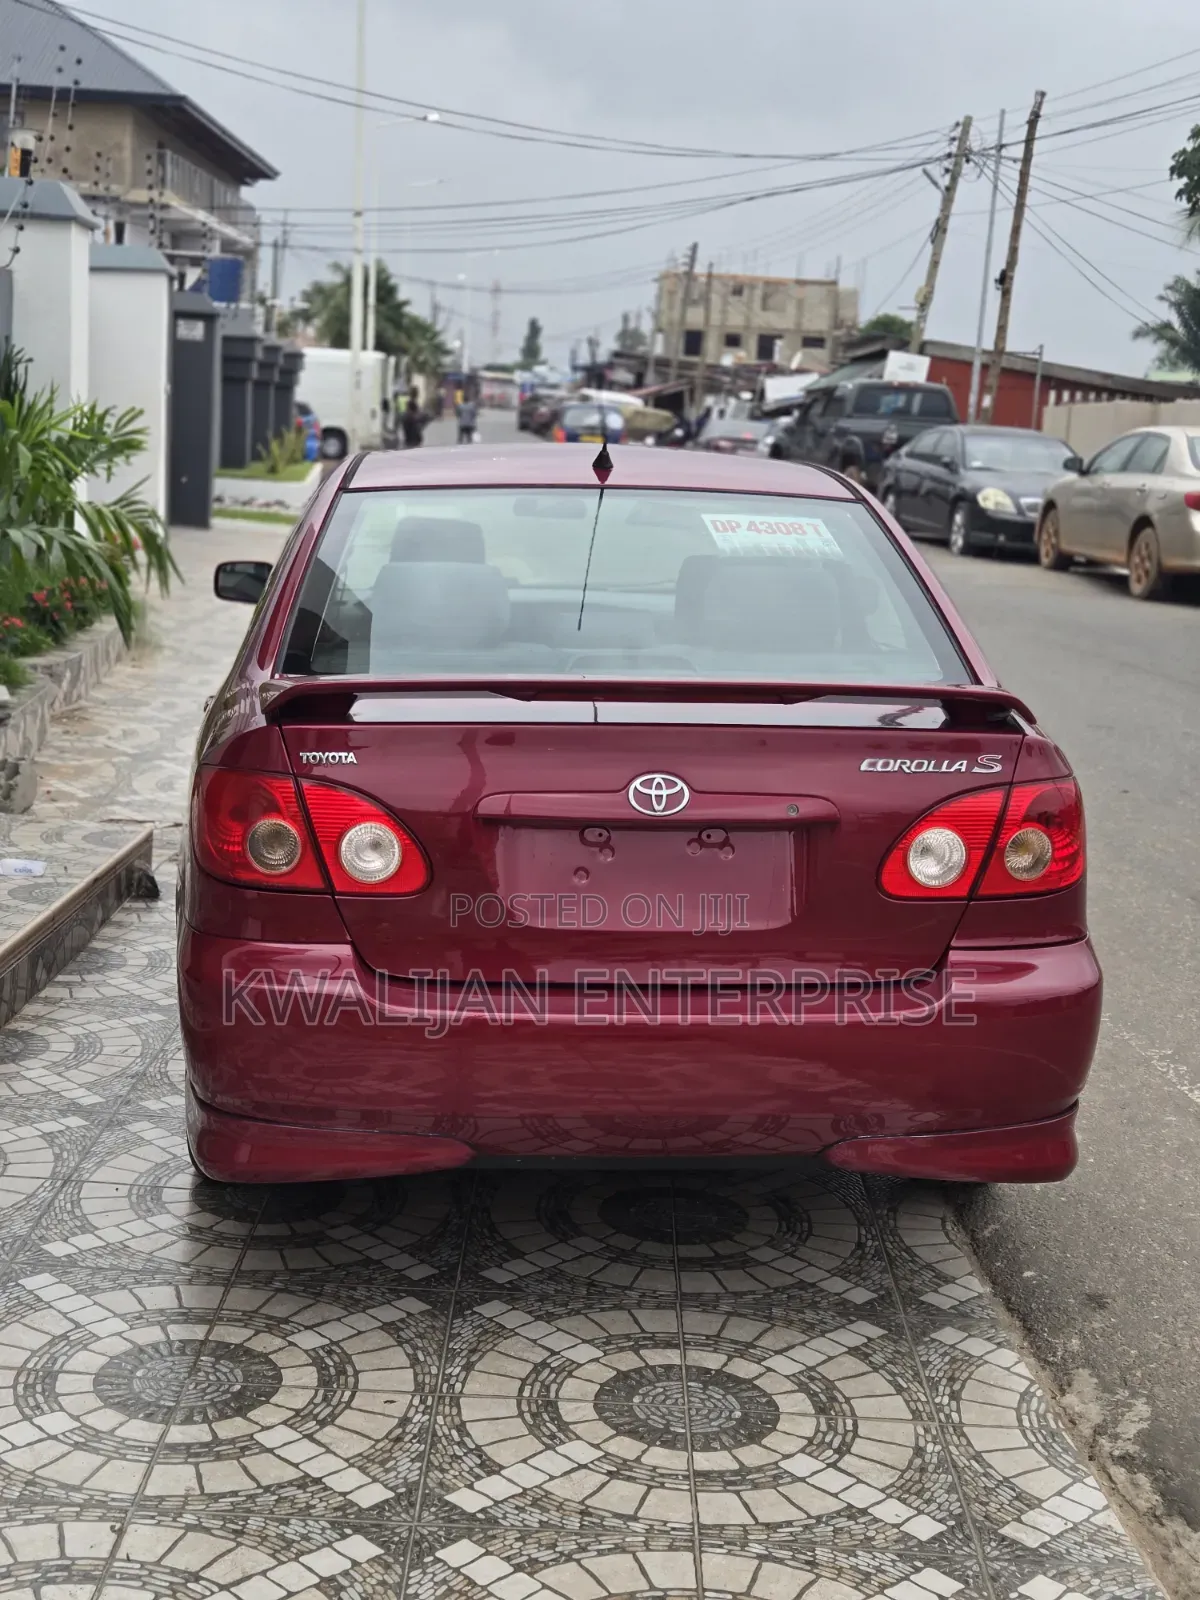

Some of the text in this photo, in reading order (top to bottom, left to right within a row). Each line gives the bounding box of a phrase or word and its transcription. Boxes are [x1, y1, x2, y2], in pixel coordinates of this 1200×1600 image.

[710, 519, 824, 538] DP 4308 T
[299, 752, 357, 764] TOYOTA
[860, 754, 1002, 774] COROLLA S
